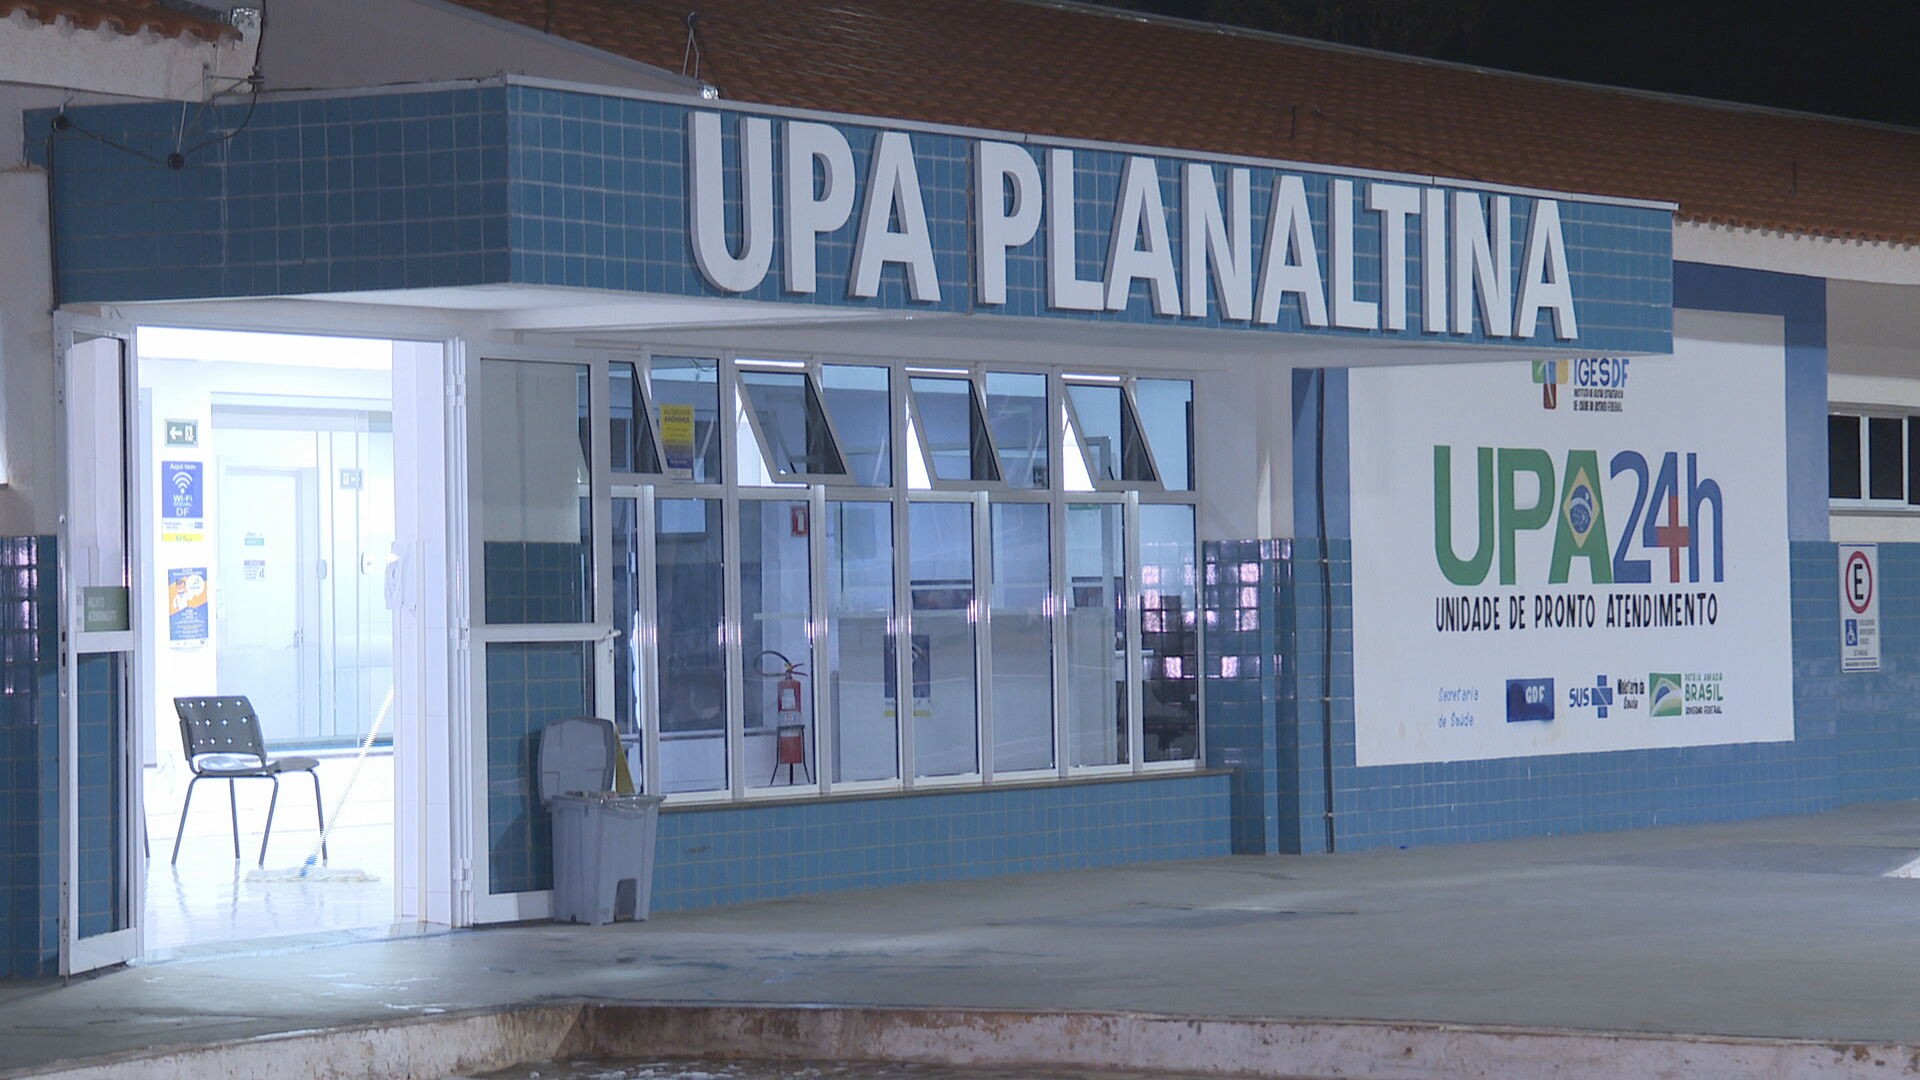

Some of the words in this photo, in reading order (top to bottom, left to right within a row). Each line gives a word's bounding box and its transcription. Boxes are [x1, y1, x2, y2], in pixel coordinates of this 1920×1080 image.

[688, 111, 942, 302] UPA
[974, 139, 1579, 340] PLANALTINA
[1573, 358, 1630, 388] IGESDF
[176, 507, 190, 517] DF
[1854, 563, 1864, 600] E
[1435, 597, 1500, 632] UNIDADE
[1509, 595, 1526, 630] DE
[1535, 594, 1595, 628] PRONTO
[1606, 593, 1718, 628] ATENDIMENTO
[1438, 687, 1479, 702] Secretaria
[1525, 684, 1545, 704] GDF
[1569, 688, 1590, 708] SUS
[1685, 683, 1723, 702] BRASIL
[1438, 713, 1447, 728] de
